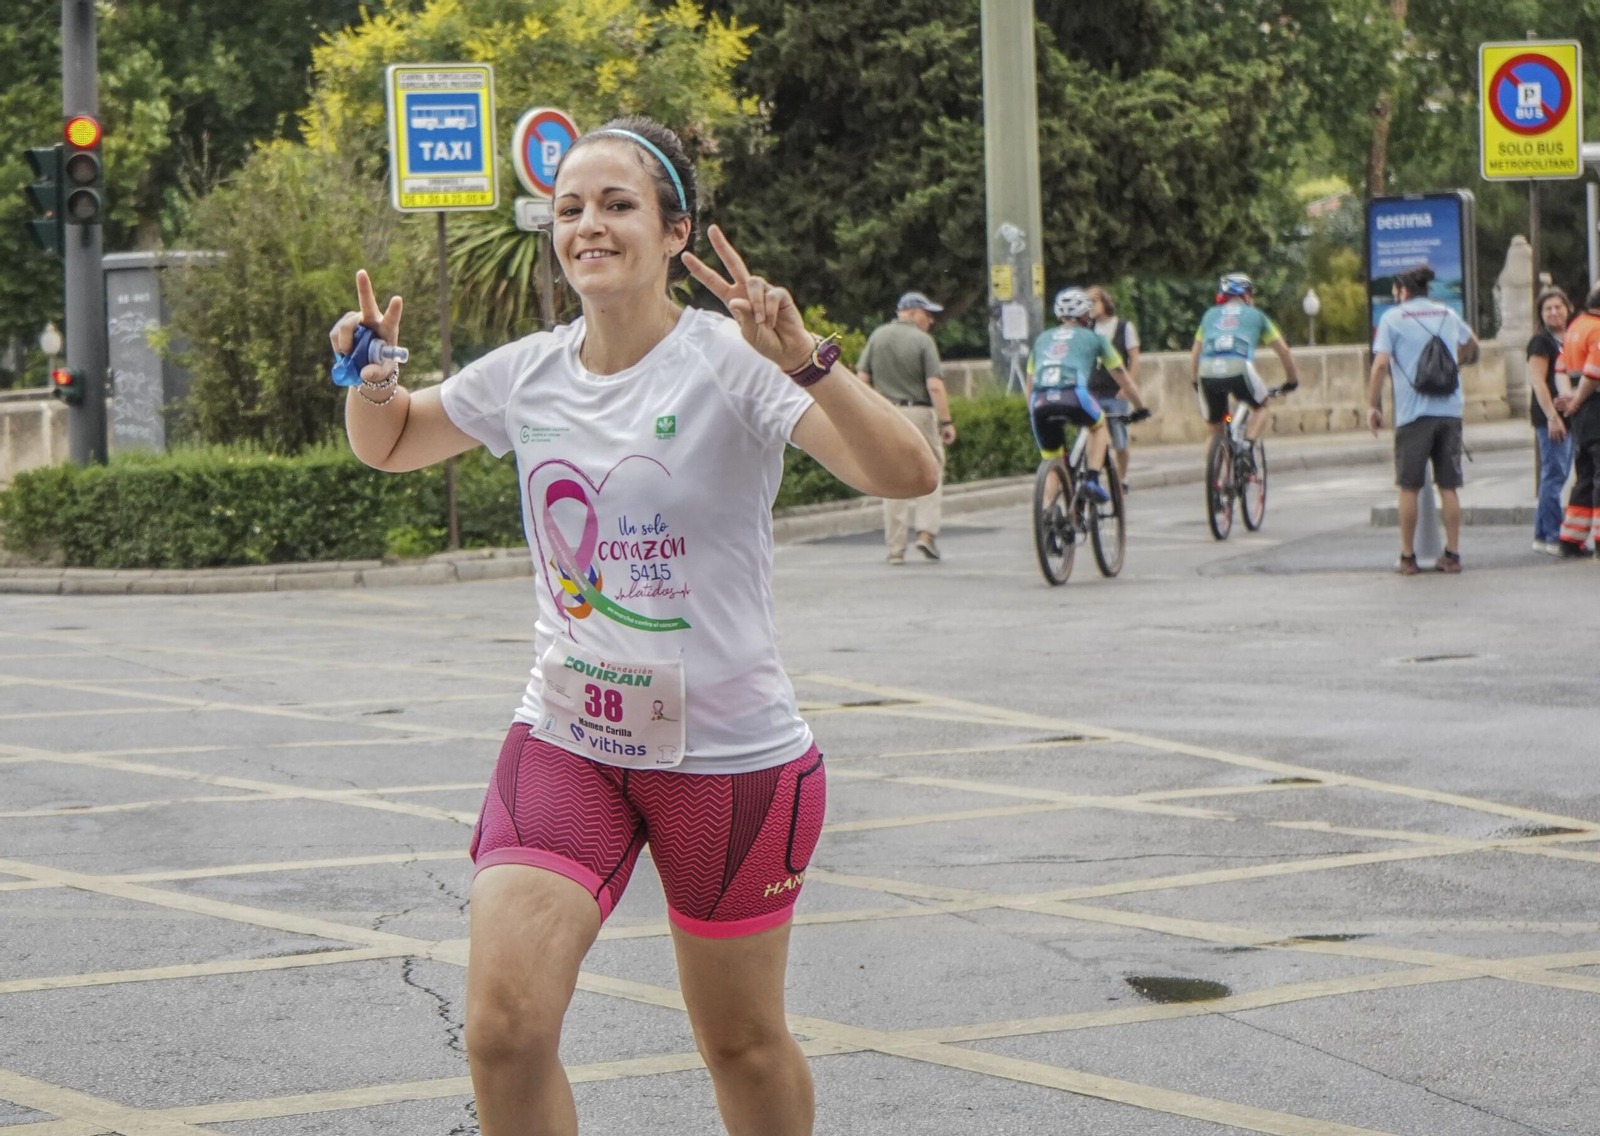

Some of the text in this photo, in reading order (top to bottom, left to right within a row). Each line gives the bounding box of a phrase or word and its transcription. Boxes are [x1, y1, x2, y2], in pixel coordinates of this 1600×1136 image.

[1525, 88, 1535, 103] P
[1515, 107, 1544, 120] BUS
[419, 141, 472, 161] TAXI
[547, 145, 556, 160] P
[1498, 142, 1564, 156] SOLO BUS
[1489, 159, 1574, 170] METROPOLITANO
[618, 513, 669, 536] Un solo
[598, 533, 686, 561] corazón
[630, 563, 671, 581] 5415
[634, 620, 653, 628] contra
[563, 656, 652, 687] COVIRAN
[607, 663, 653, 674] Fundación
[584, 683, 623, 722] 38
[578, 716, 632, 737] Mamen Carilla
[589, 735, 647, 756] vithas
